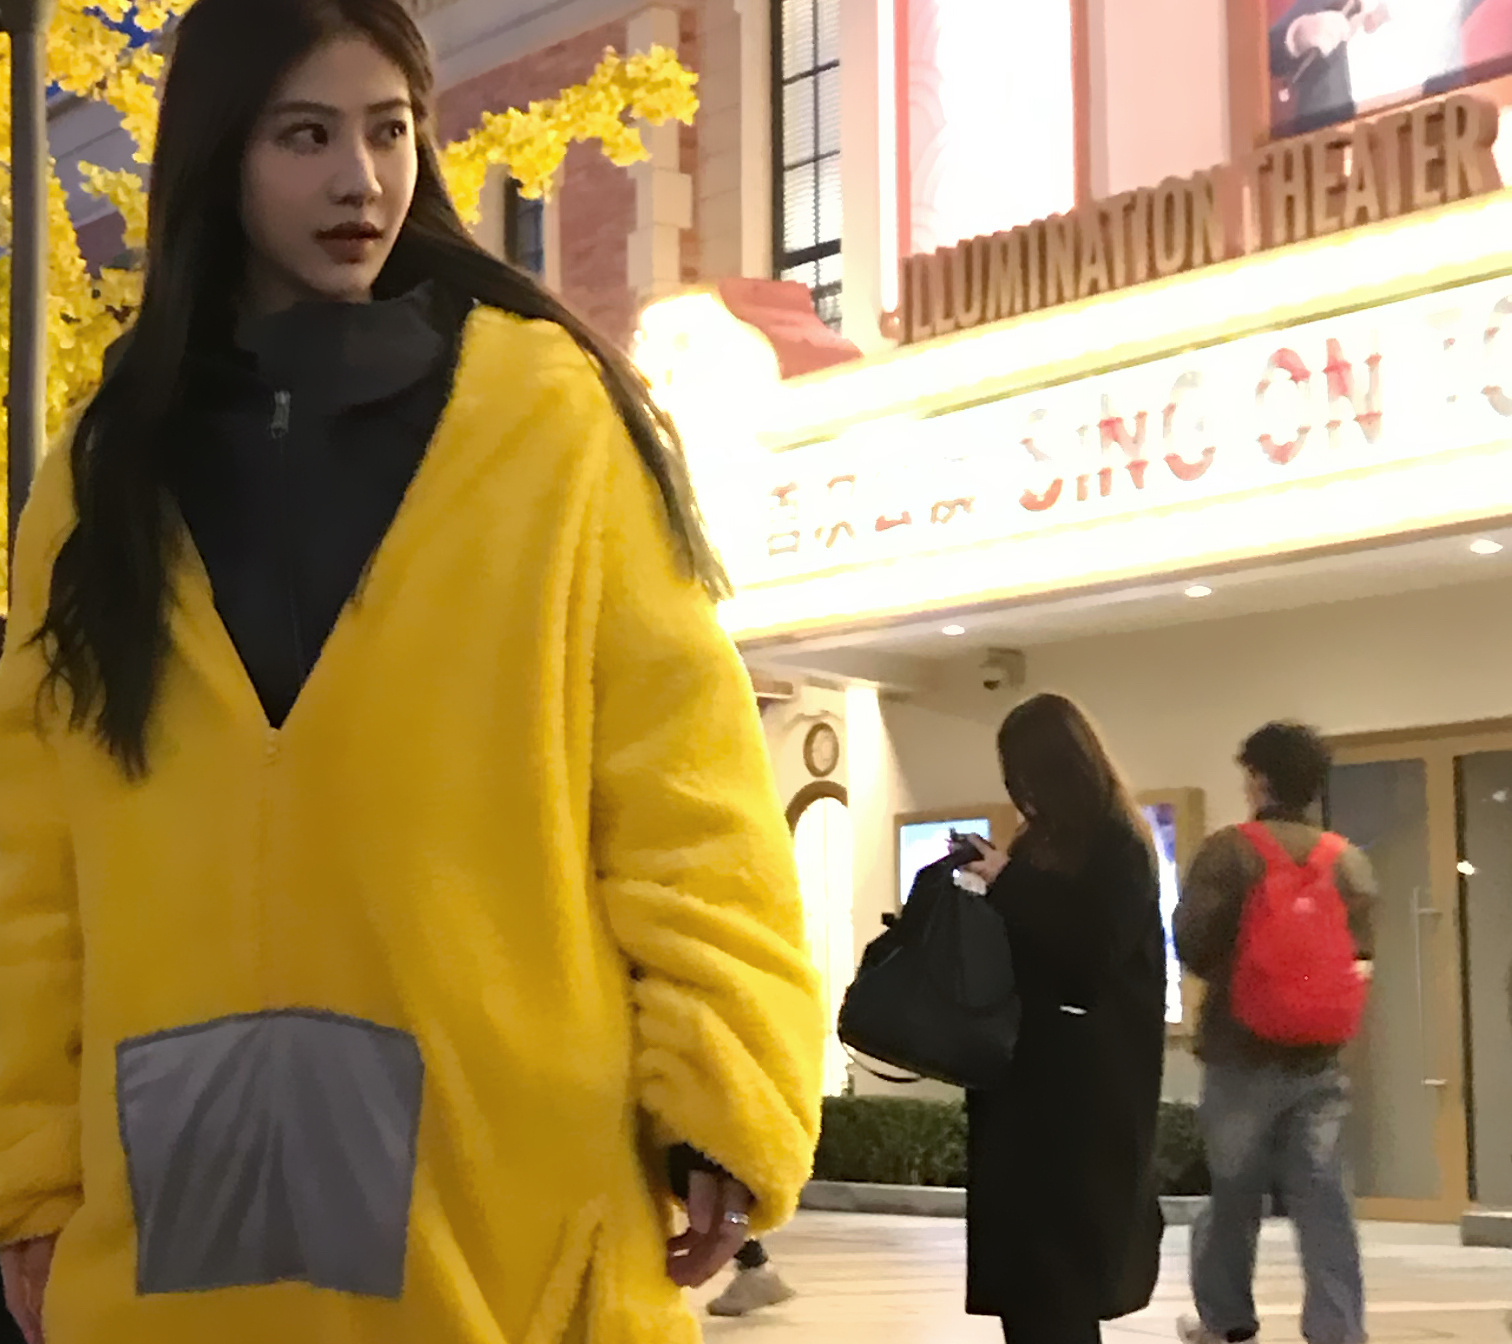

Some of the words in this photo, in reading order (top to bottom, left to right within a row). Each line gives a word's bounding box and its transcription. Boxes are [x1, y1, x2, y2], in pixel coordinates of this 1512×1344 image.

[899, 164, 1228, 345] ILLUMINATION
[1230, 93, 1492, 257] THEATER
[1255, 336, 1384, 466] ON
